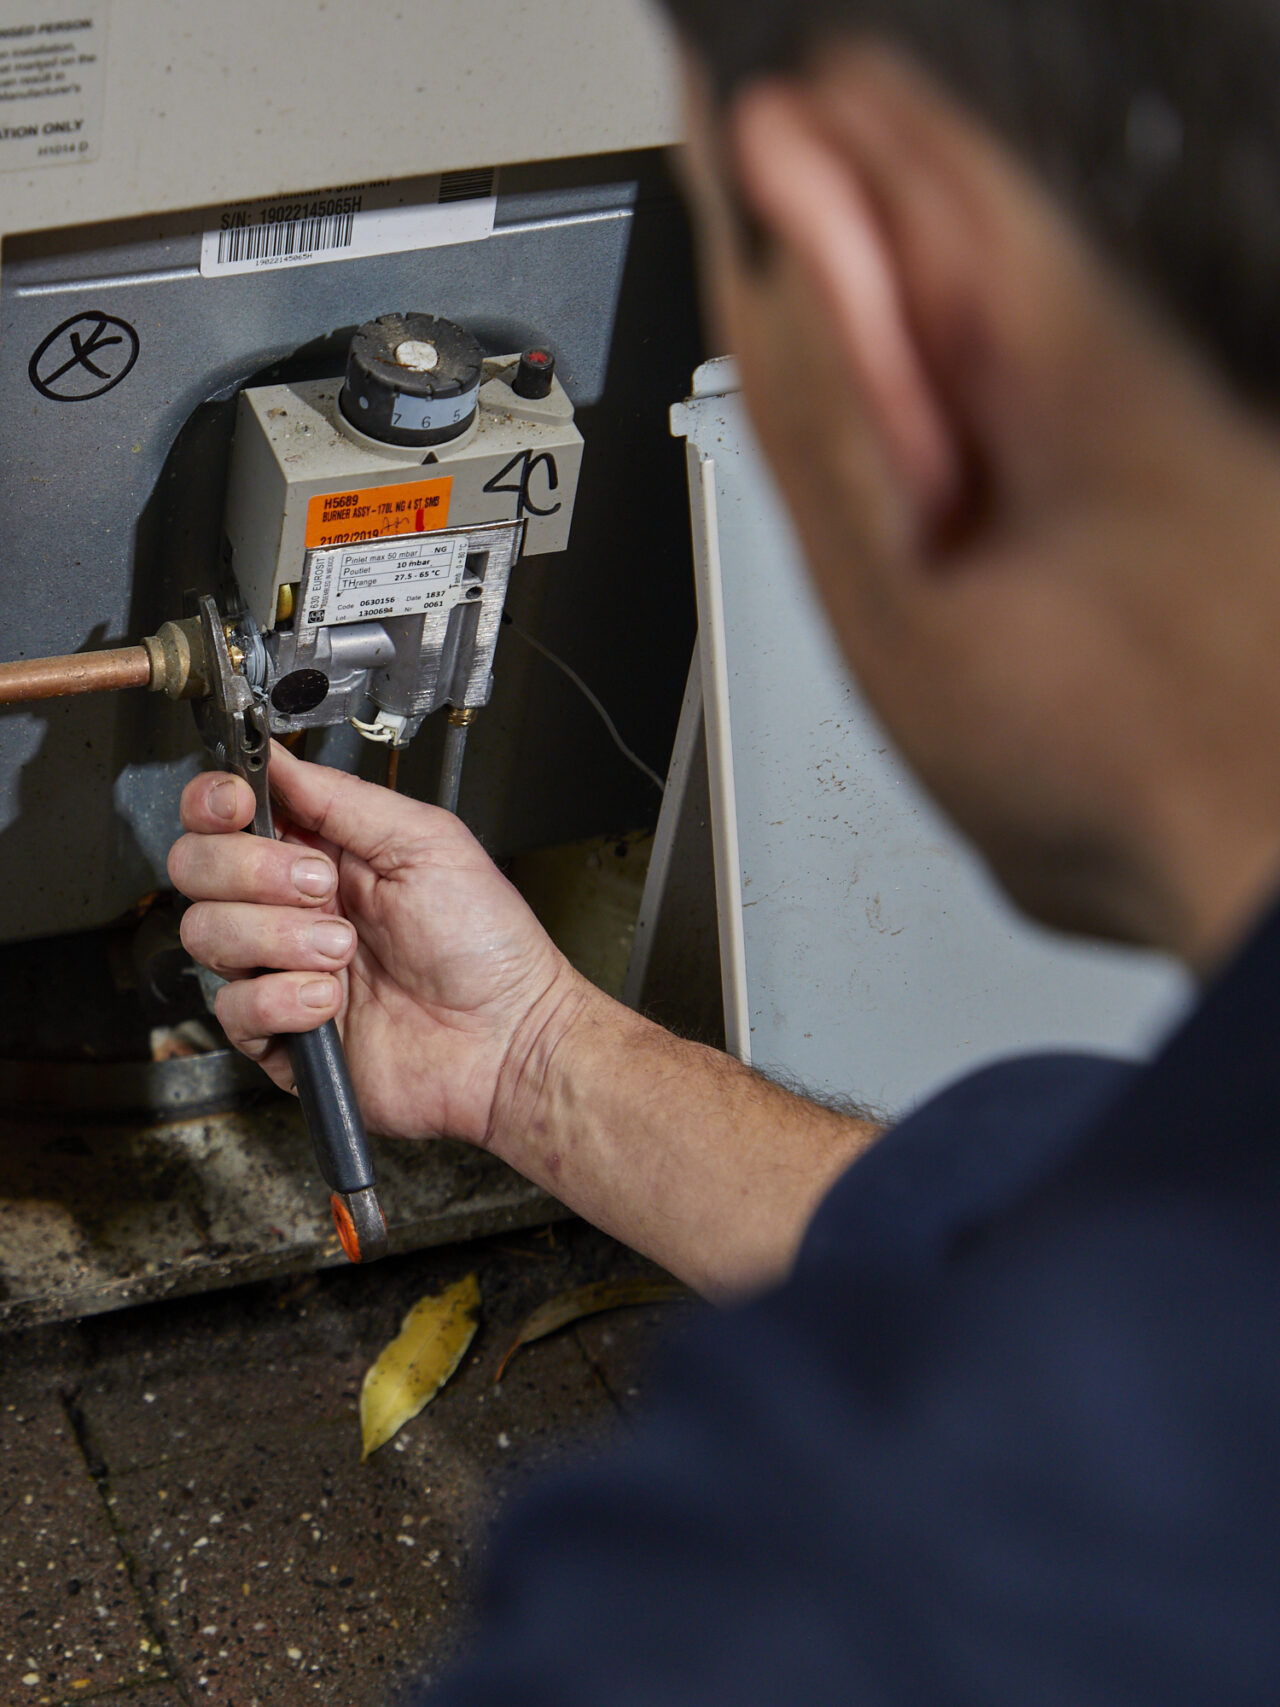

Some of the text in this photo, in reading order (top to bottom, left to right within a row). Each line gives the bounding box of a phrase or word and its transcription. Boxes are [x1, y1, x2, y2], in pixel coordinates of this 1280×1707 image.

[42, 118, 83, 133] ONLY
[221, 196, 362, 230] S/N: 19022145065H
[393, 408, 461, 429] 7 6 5
[322, 507, 350, 523] BURNER
[352, 505, 370, 518] ASSY
[370, 554, 385, 562] max
[399, 549, 418, 559] mbar
[434, 546, 447, 554] NG
[397, 561, 407, 569] 10
[312, 557, 325, 591] EUROSIT
[394, 573, 413, 582] 27.5
[420, 570, 430, 579] 65
[426, 590, 446, 599] 1837
[337, 602, 355, 611] Code
[423, 600, 444, 609] 0061
